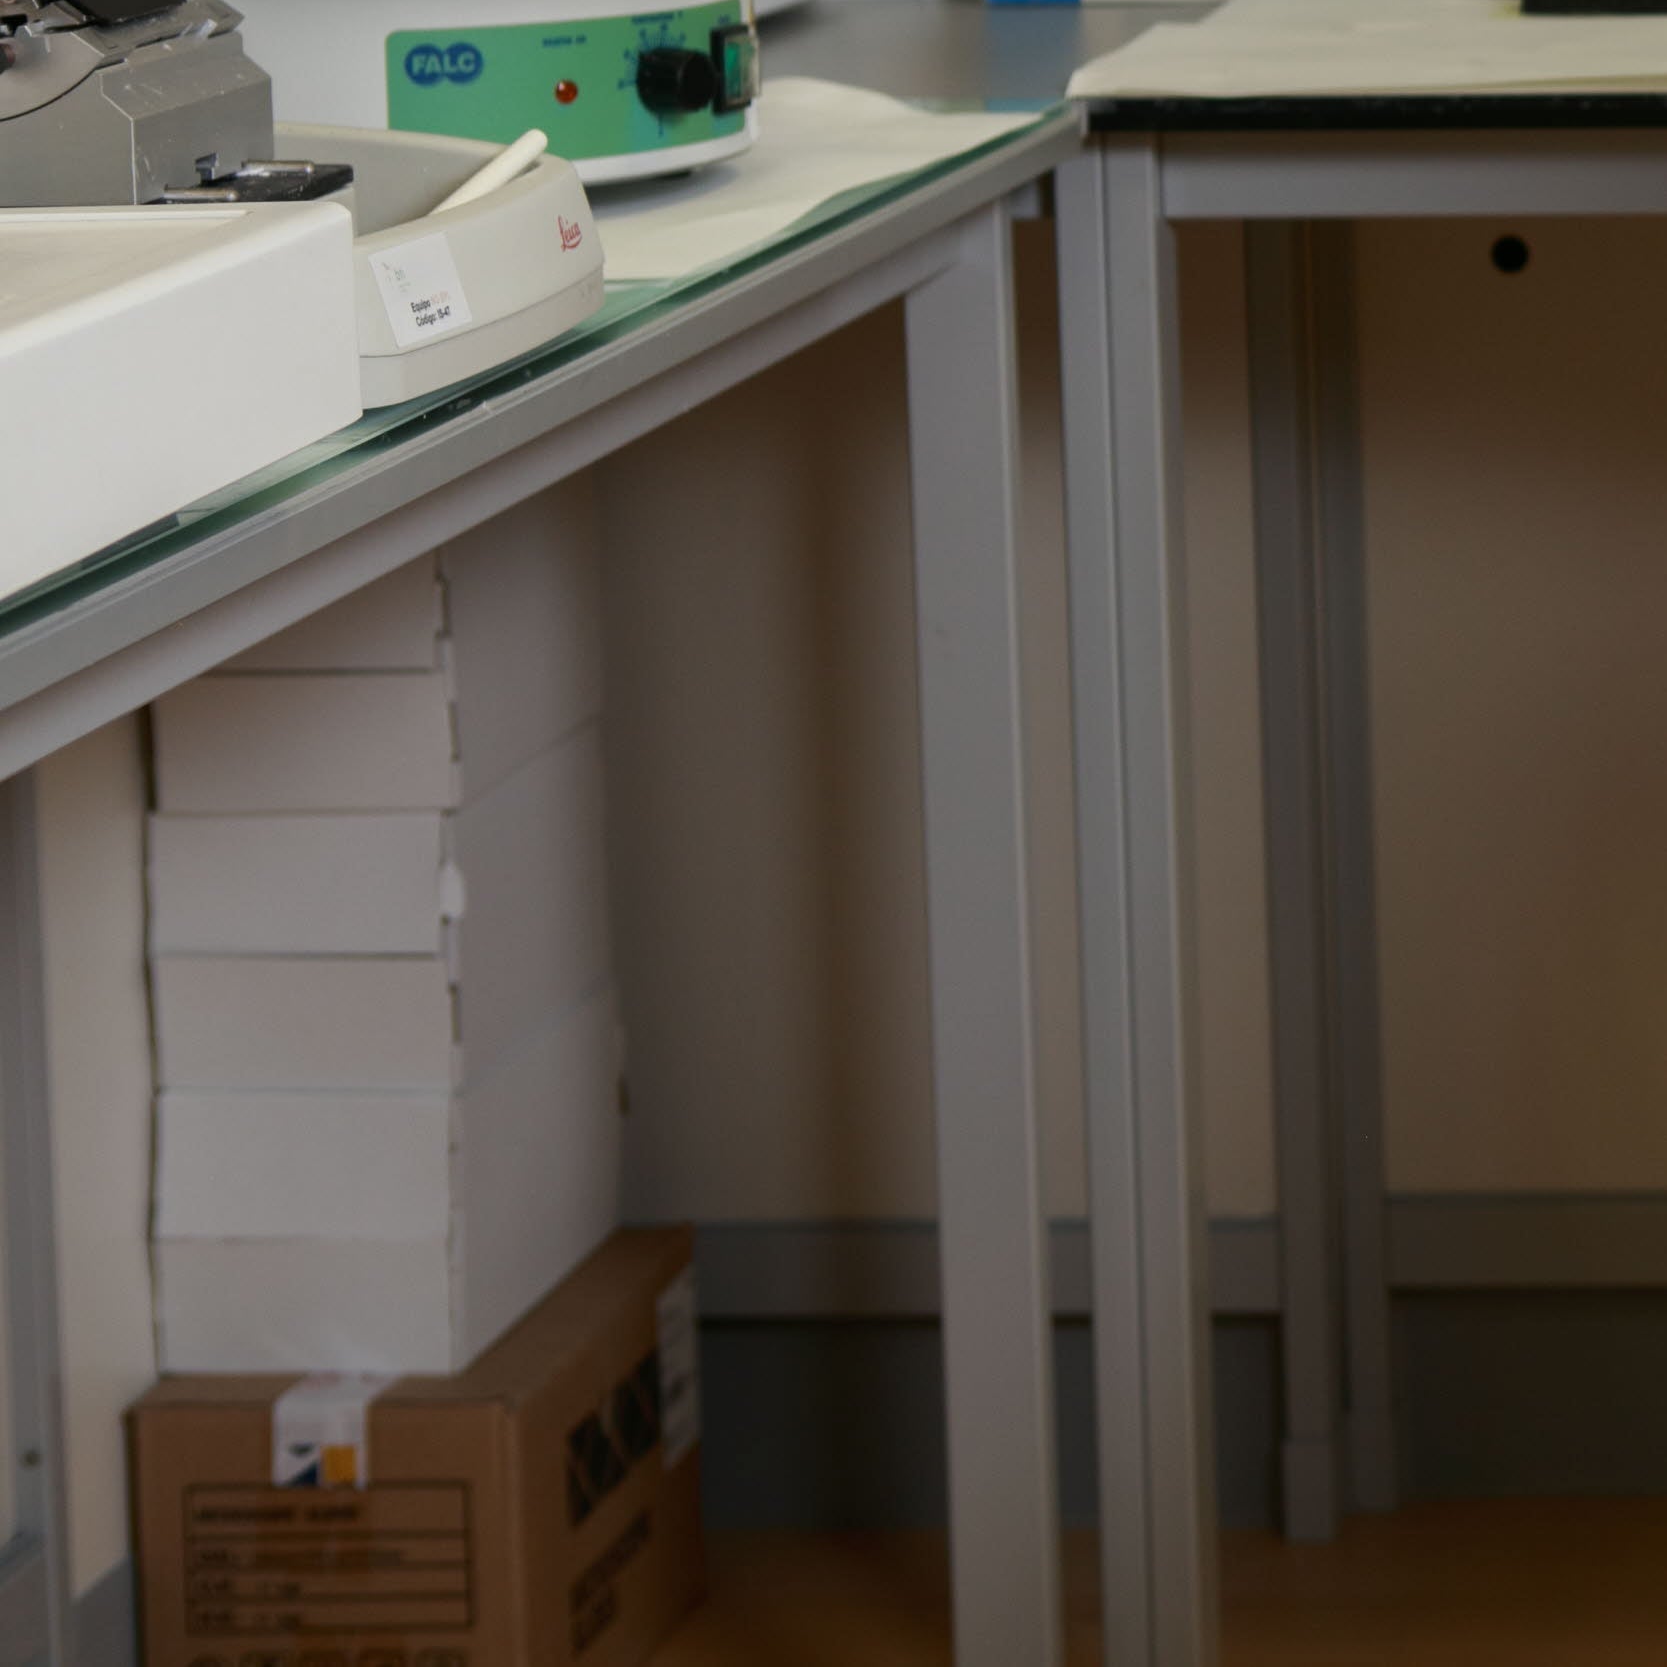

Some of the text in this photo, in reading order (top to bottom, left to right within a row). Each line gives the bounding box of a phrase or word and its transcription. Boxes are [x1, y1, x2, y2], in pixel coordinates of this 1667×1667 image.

[411, 50, 477, 75] FALC
[558, 215, 583, 253] Leica
[410, 299, 431, 313] Equipo
